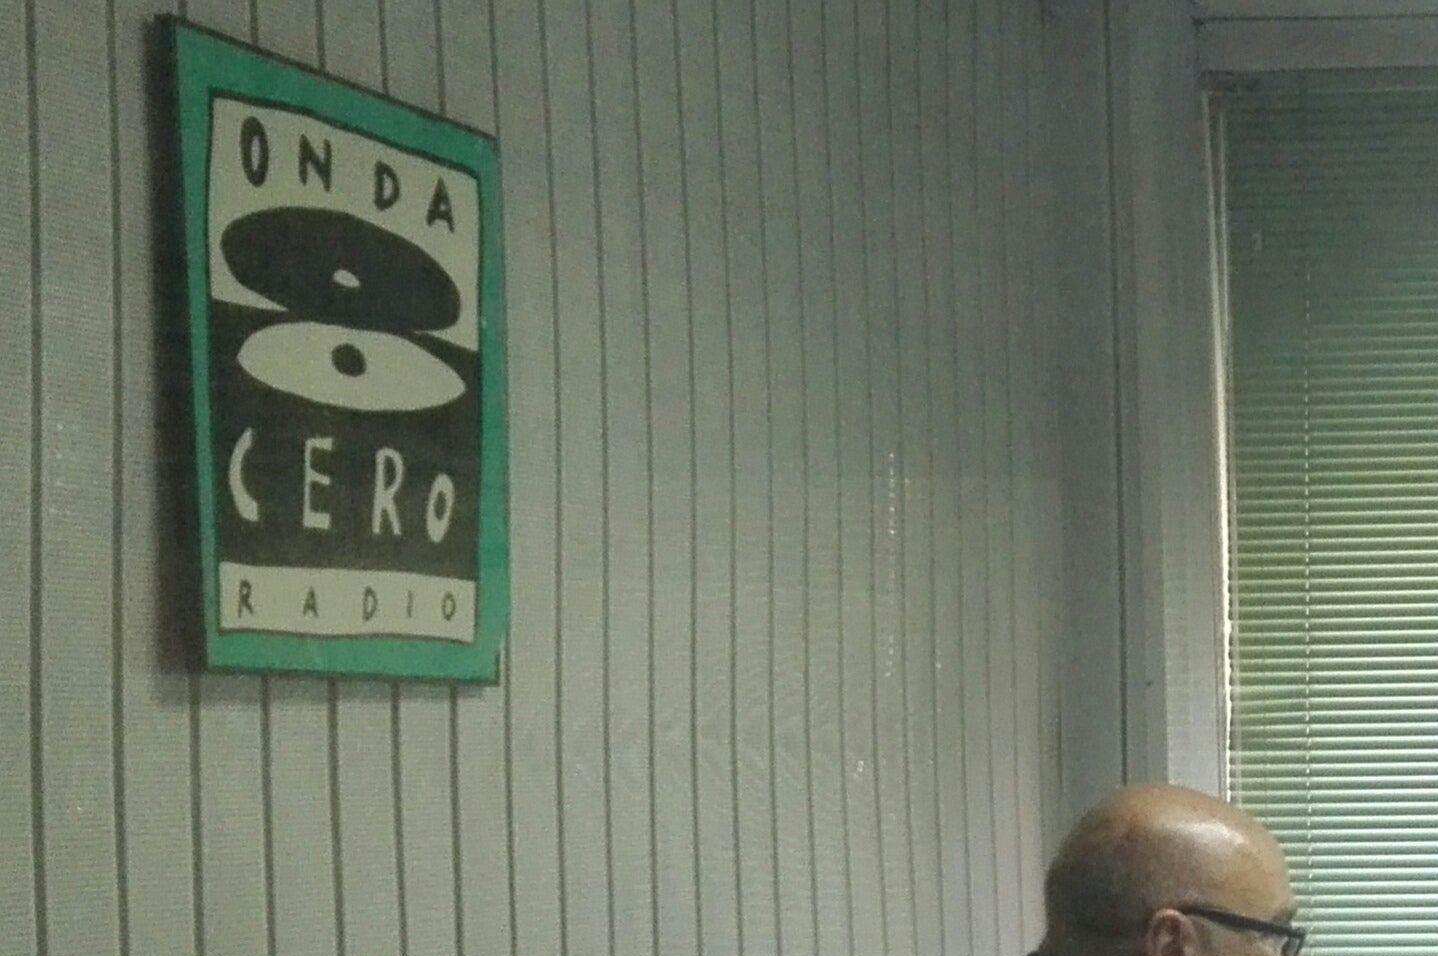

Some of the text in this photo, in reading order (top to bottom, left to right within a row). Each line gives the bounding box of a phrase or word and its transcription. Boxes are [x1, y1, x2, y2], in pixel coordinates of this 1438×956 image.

[240, 115, 455, 233] ONDA
[229, 427, 455, 544] CERO
[237, 578, 456, 622] RADIO
